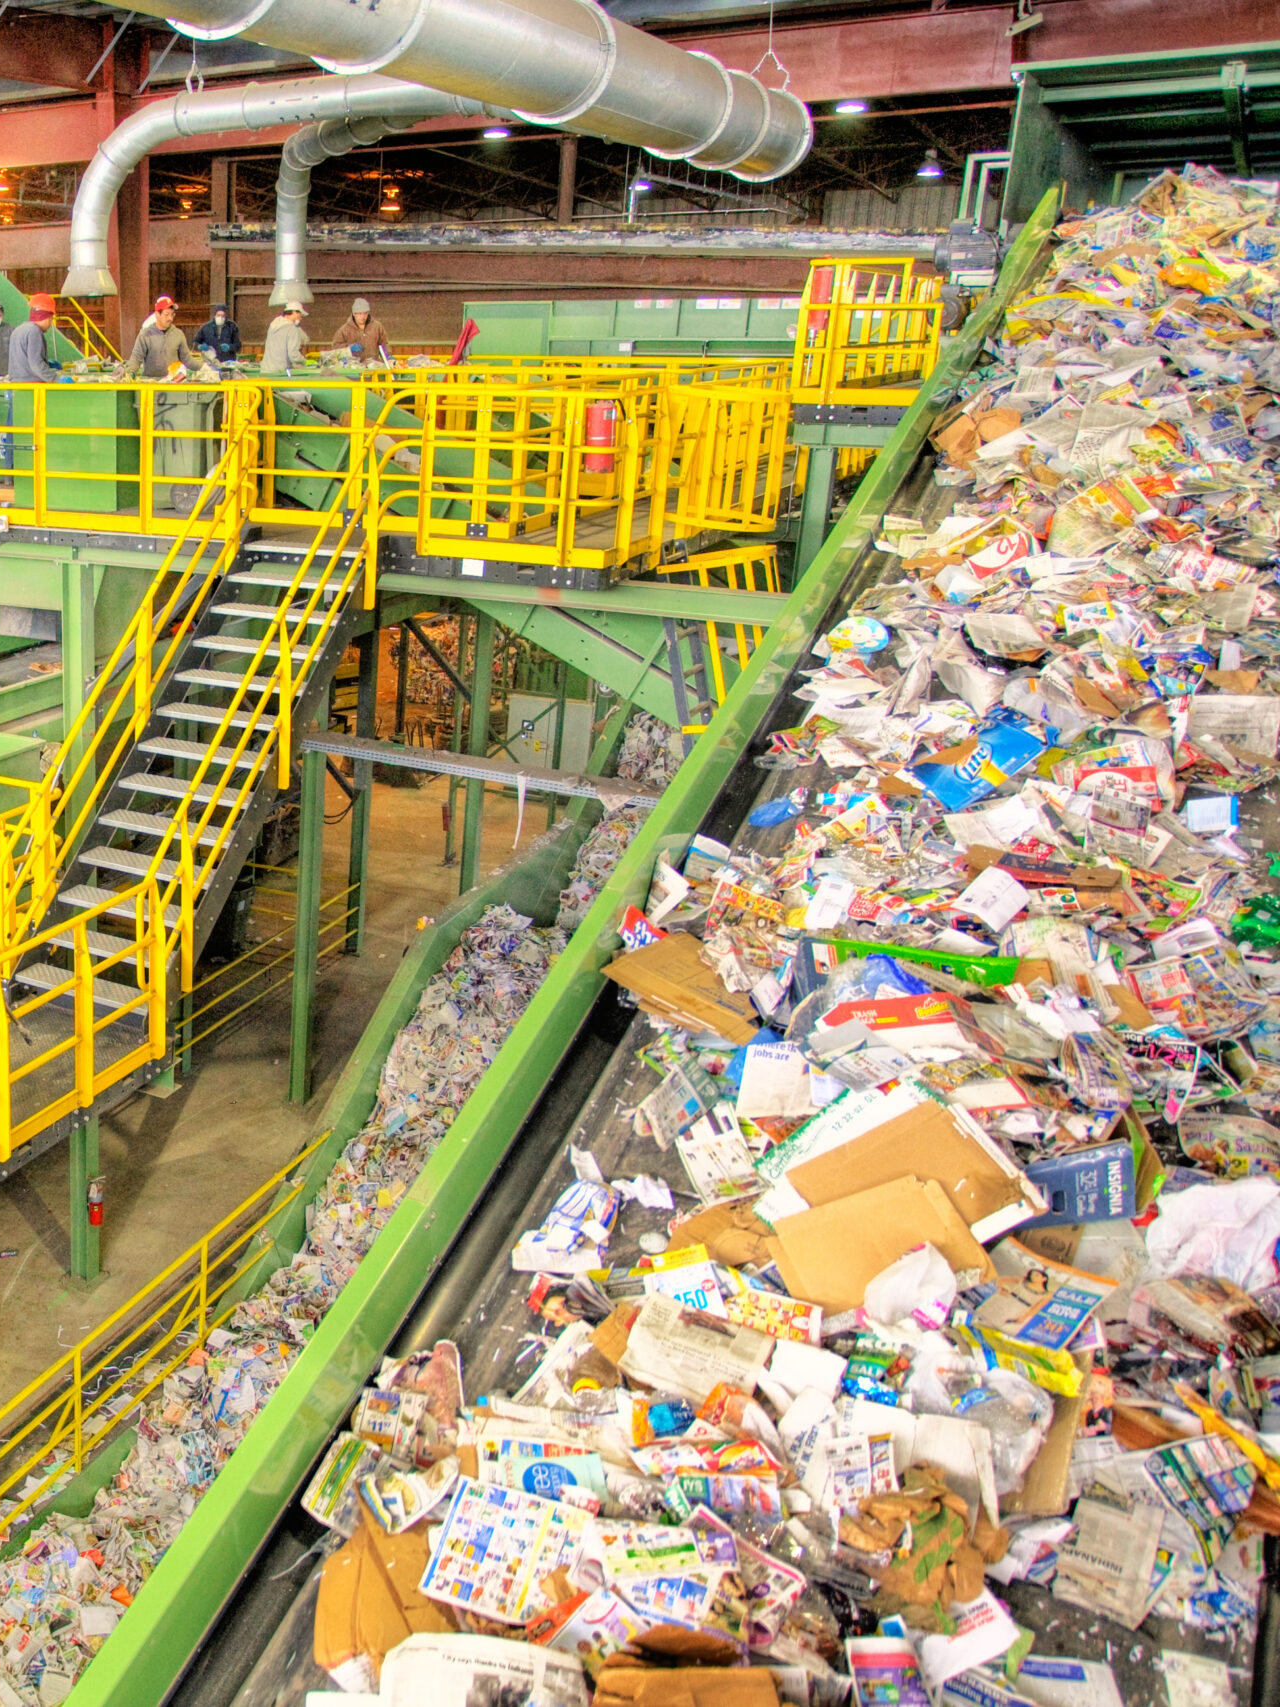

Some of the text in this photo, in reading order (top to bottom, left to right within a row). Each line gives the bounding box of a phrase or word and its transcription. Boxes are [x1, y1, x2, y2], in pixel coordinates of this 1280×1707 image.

[753, 1048, 773, 1059] jobs
[1107, 1160, 1123, 1215] INSIGNIA
[1056, 1289, 1097, 1306] SALE
[956, 1673, 1009, 1705] ENARDS
